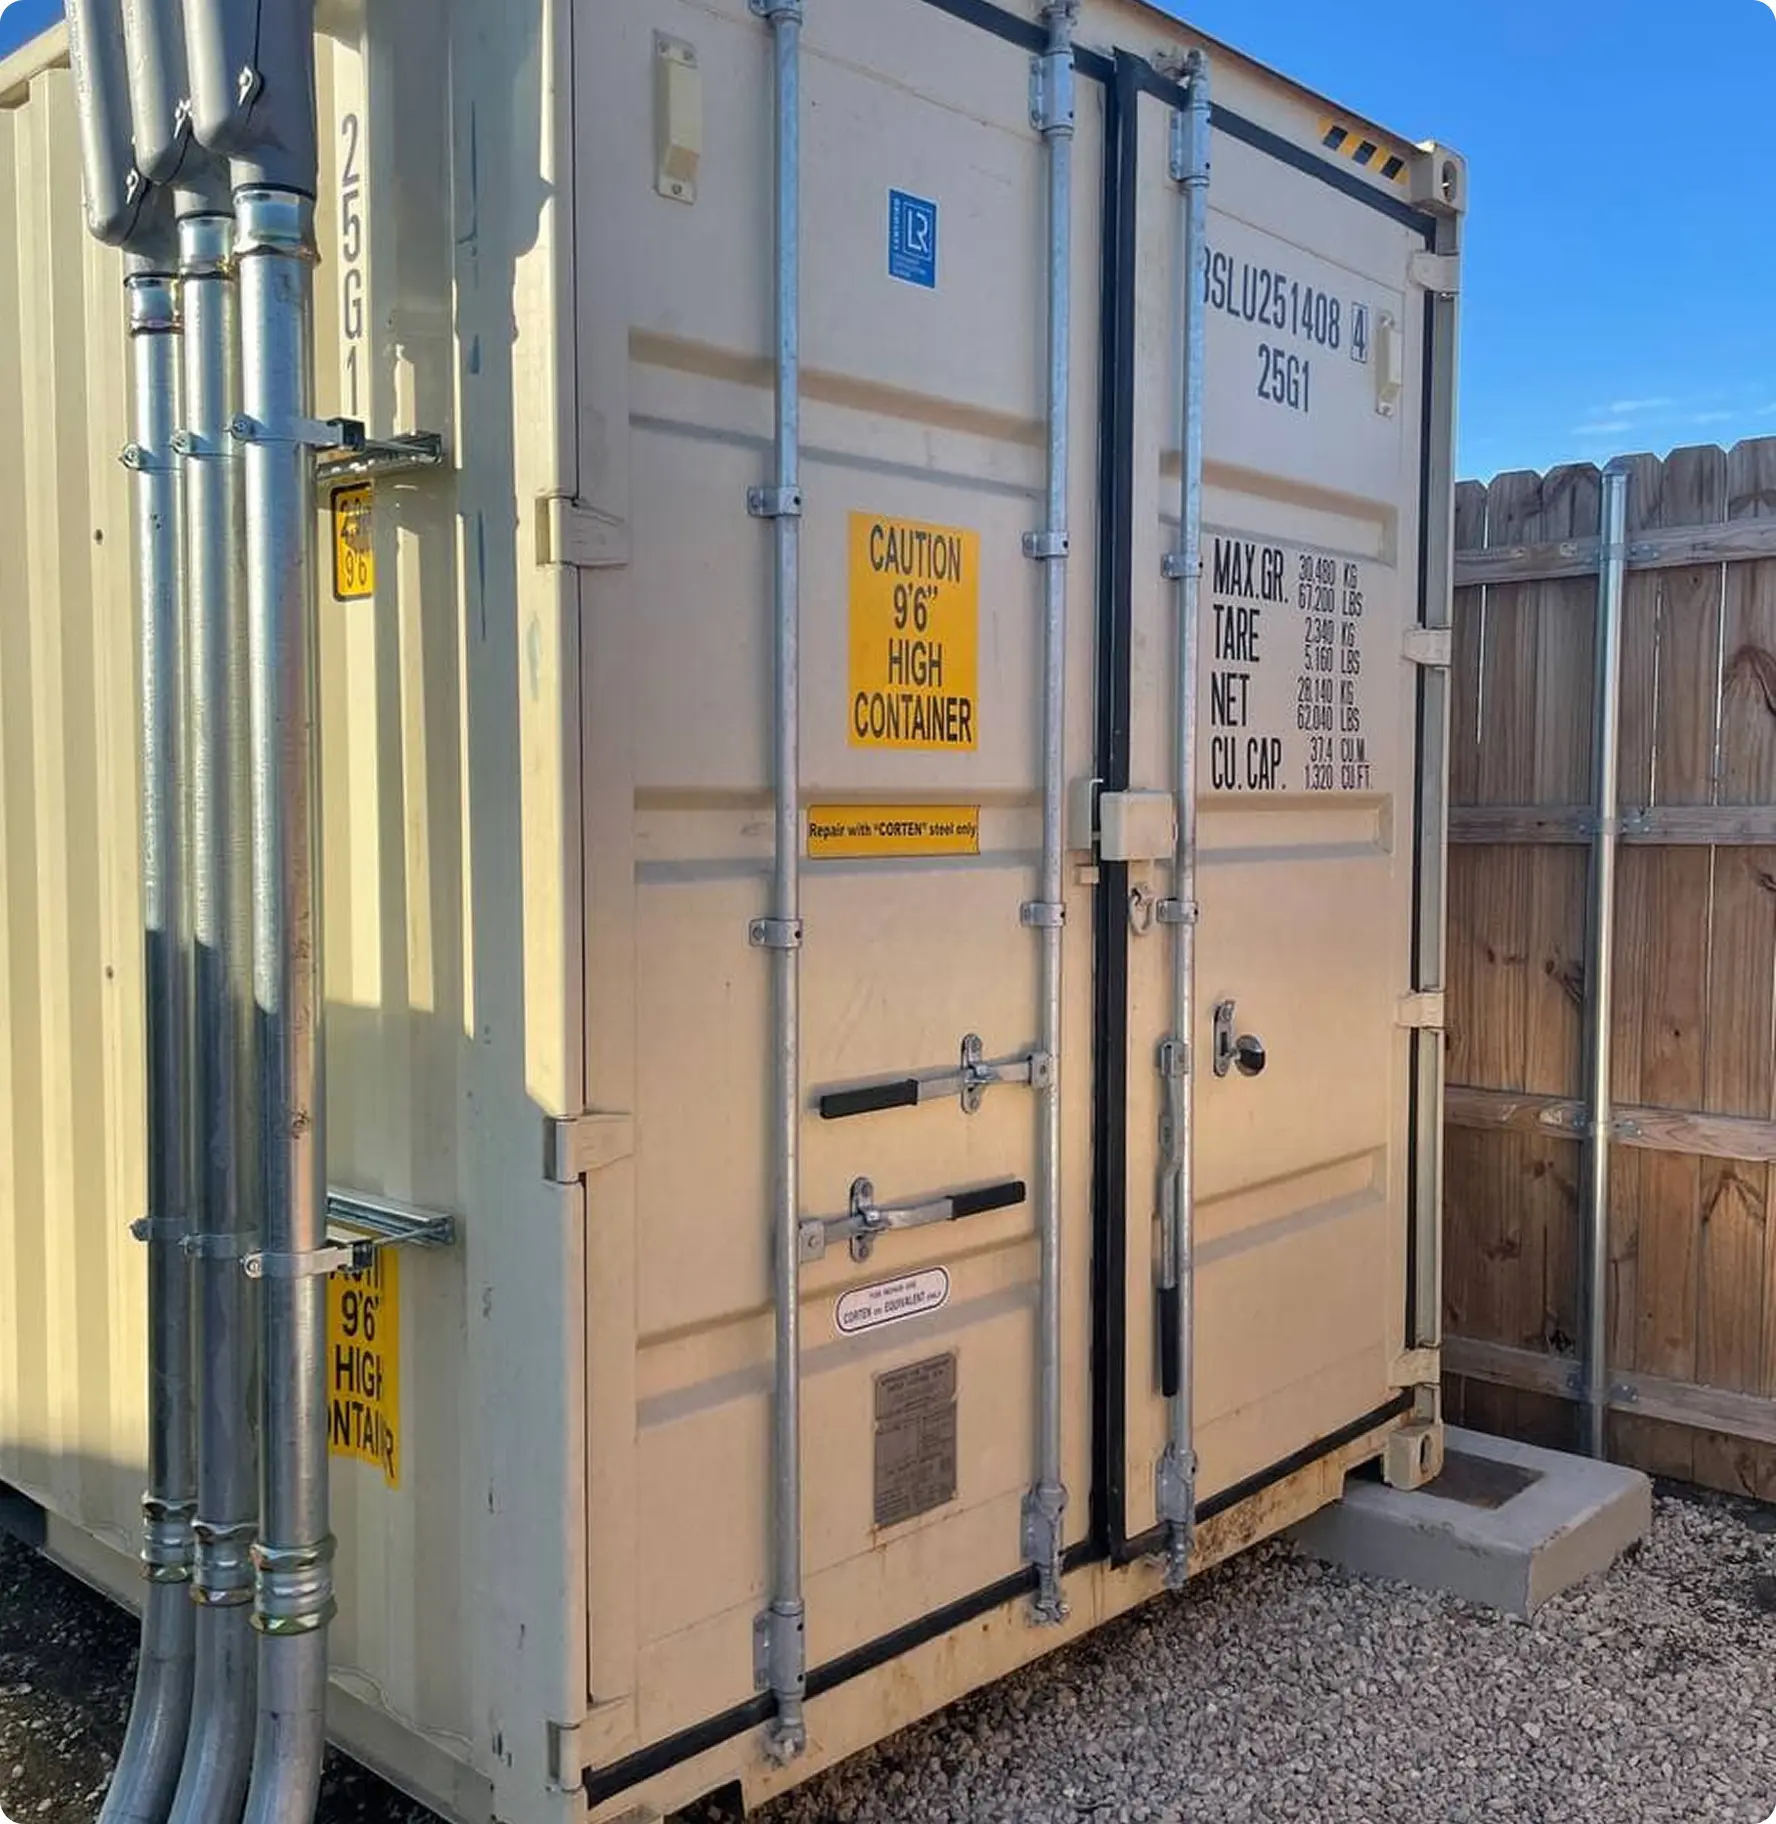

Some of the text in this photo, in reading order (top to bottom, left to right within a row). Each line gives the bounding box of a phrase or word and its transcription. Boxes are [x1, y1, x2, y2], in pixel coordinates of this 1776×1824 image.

[907, 208, 929, 254] LR
[341, 113, 363, 416] 25G1
[1351, 305, 1366, 361] 4
[1257, 343, 1310, 413] 25G1
[869, 524, 961, 583] CAUTION
[1342, 590, 1363, 617] LBS
[1213, 604, 1260, 662] TARE
[1341, 621, 1355, 648] KG
[888, 638, 943, 687] HIGH
[1340, 649, 1361, 675] LBS
[853, 691, 972, 743] CONTAINER
[1211, 672, 1250, 727] NET
[1340, 706, 1360, 732] LBS
[809, 822, 845, 839] Repair
[848, 822, 872, 836] with
[929, 823, 954, 837] steel
